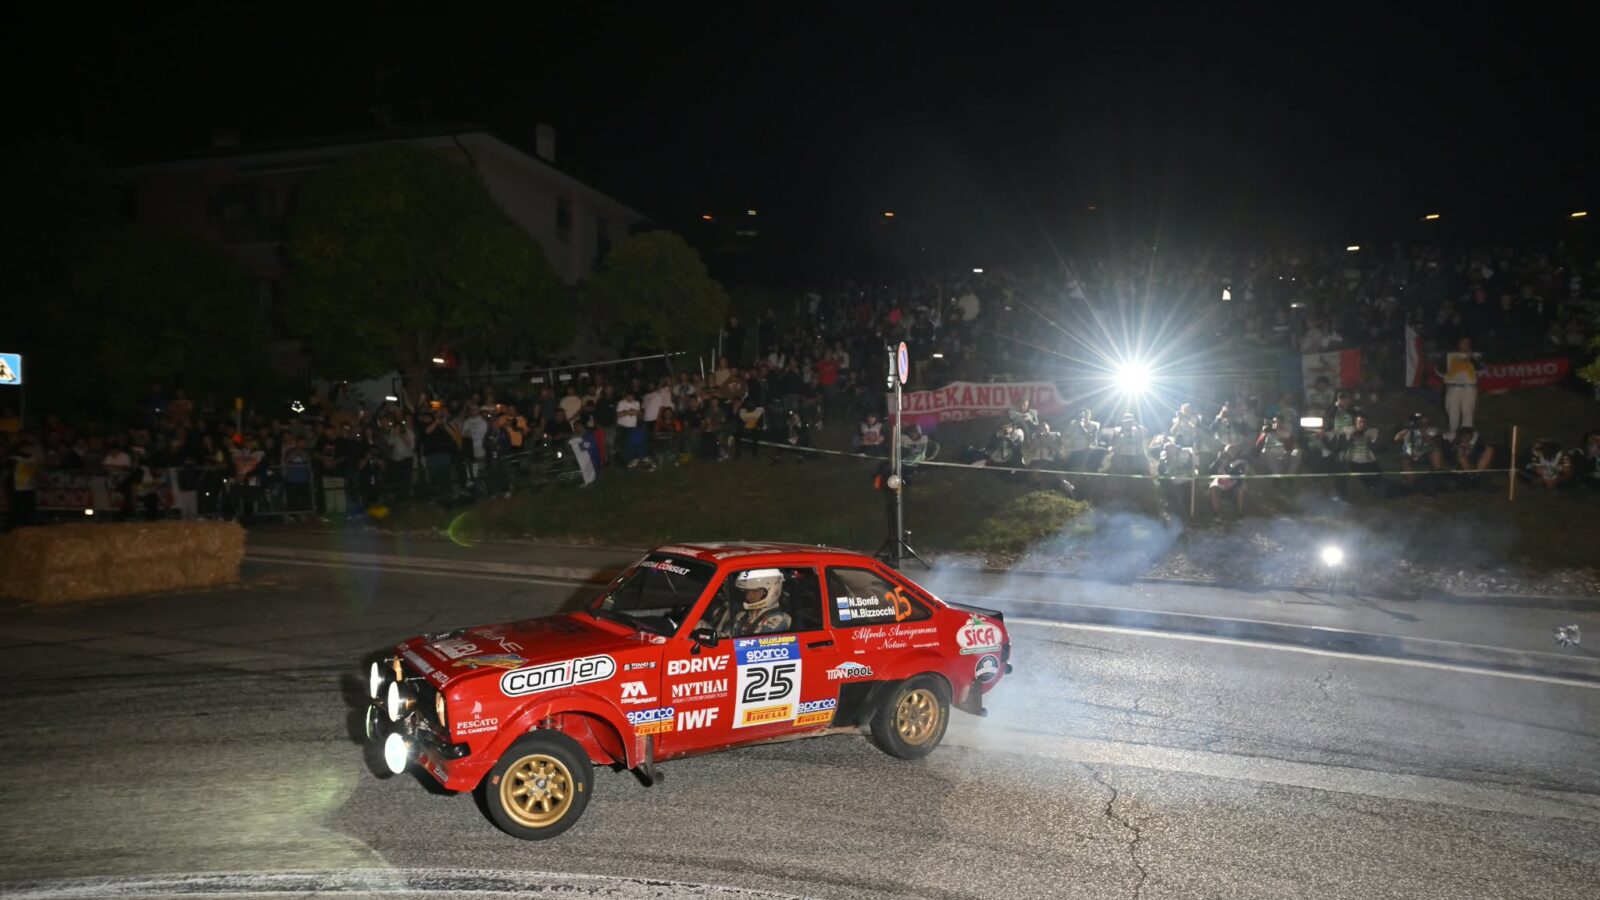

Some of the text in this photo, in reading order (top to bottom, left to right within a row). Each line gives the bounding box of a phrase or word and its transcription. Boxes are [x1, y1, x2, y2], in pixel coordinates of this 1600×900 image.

[658, 563, 690, 576] CONSULT
[884, 586, 912, 622] 25
[851, 607, 895, 619] M.Bizzocchi
[852, 625, 937, 642] Alfredo Aurigemma
[877, 638, 908, 650] Notaio
[746, 647, 789, 663] sparco
[509, 659, 606, 690] comifer
[671, 678, 728, 698] MYTHAI
[742, 663, 796, 703] 25
[746, 706, 788, 722] PIRELLI
[798, 698, 837, 714] sparco
[457, 717, 498, 729] PESCATO
[626, 707, 675, 724] sparco
[677, 707, 719, 731] IWF
[797, 712, 830, 724] PIRELLI
